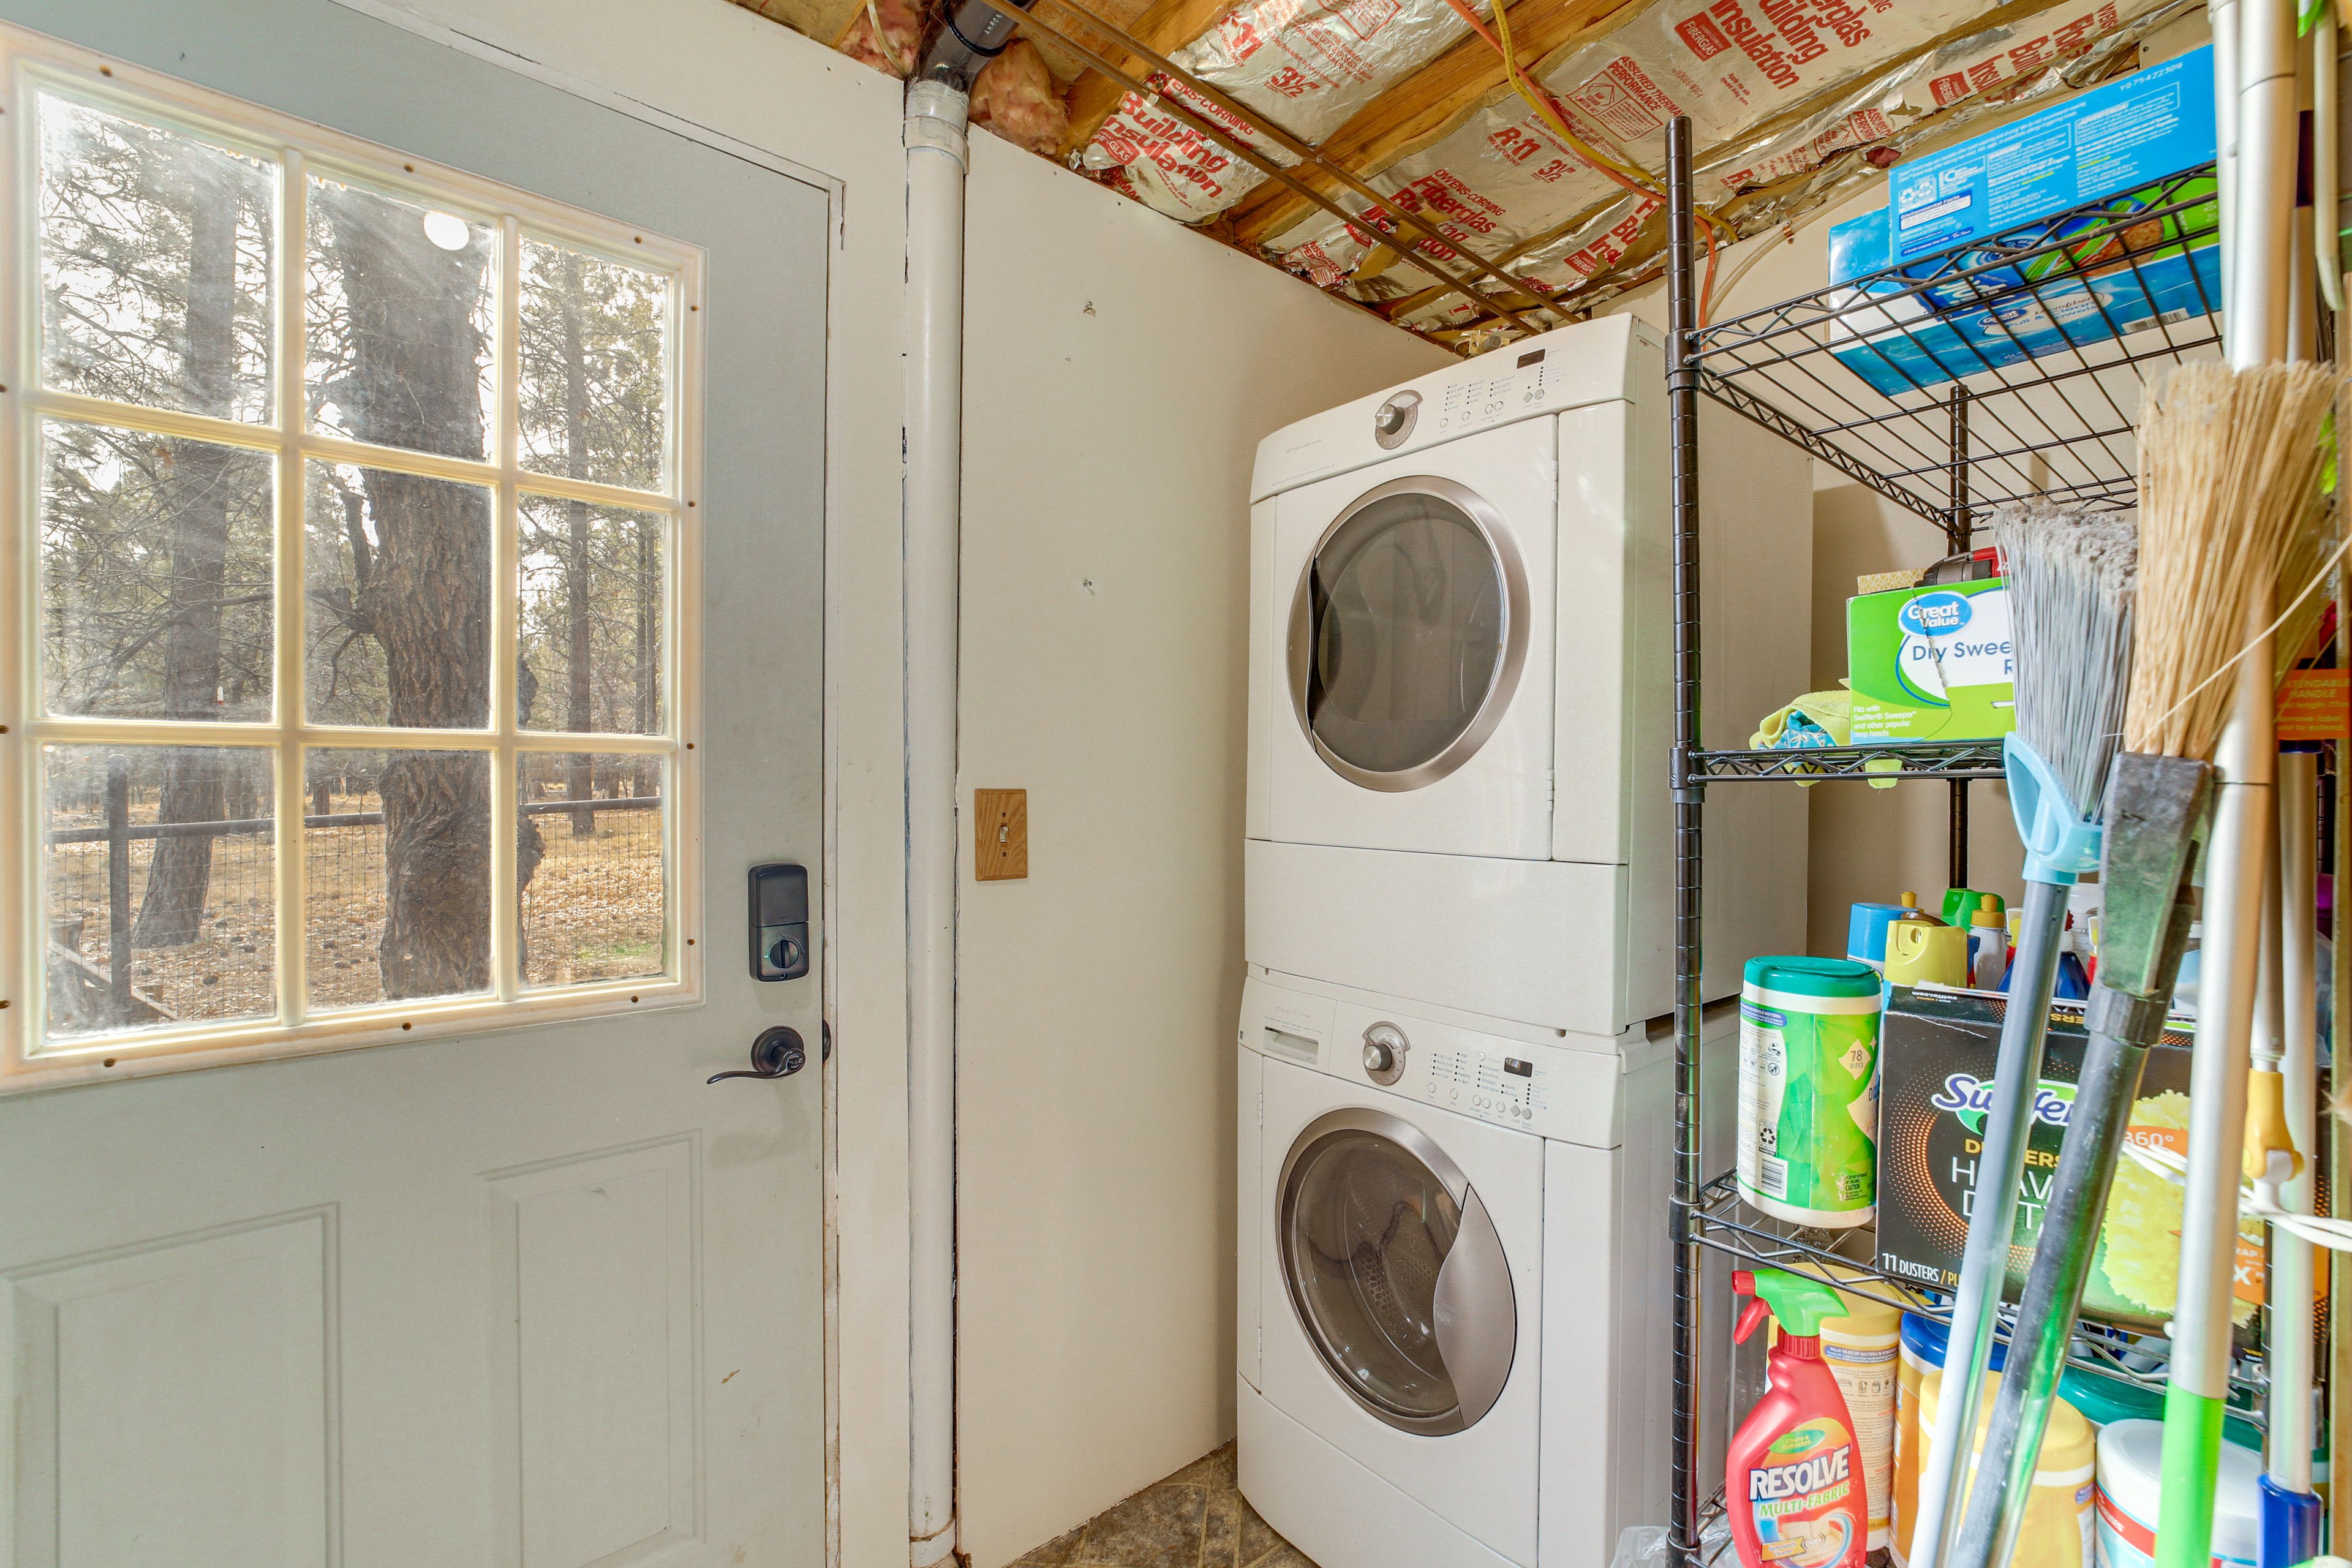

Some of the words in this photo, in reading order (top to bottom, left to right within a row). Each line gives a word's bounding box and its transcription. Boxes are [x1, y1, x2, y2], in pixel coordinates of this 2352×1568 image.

[1319, 34, 1334, 48] LEFT
[1683, 21, 1717, 56] FIBERGLAS
[1619, 56, 1655, 91] ASSURED
[1607, 62, 1662, 111] PERFORMANCE
[1117, 91, 1229, 173] Building
[1493, 127, 1541, 161] R-11
[1104, 116, 1223, 198] nsulation
[1434, 168, 1506, 216] OWENS-CORNING
[1943, 195, 1960, 204] Facts
[2054, 306, 2098, 319] owels
[2005, 318, 2030, 328] Pull
[1907, 601, 1960, 620] Great
[1920, 617, 1959, 628] Value
[1913, 646, 1947, 663] Dry
[1886, 720, 1910, 729] popular
[1912, 990, 1958, 1000] swiffer.com
[1851, 1050, 1863, 1061] 78
[1882, 1253, 1897, 1271] 11
[1899, 1261, 1939, 1283] DUSTERS
[1781, 1440, 1811, 1450] Refreshes
[1785, 1436, 1803, 1444] Cleans
[1749, 1444, 1850, 1501] RESOLVE
[1759, 1481, 1850, 1517] MULTI-FABRIC
